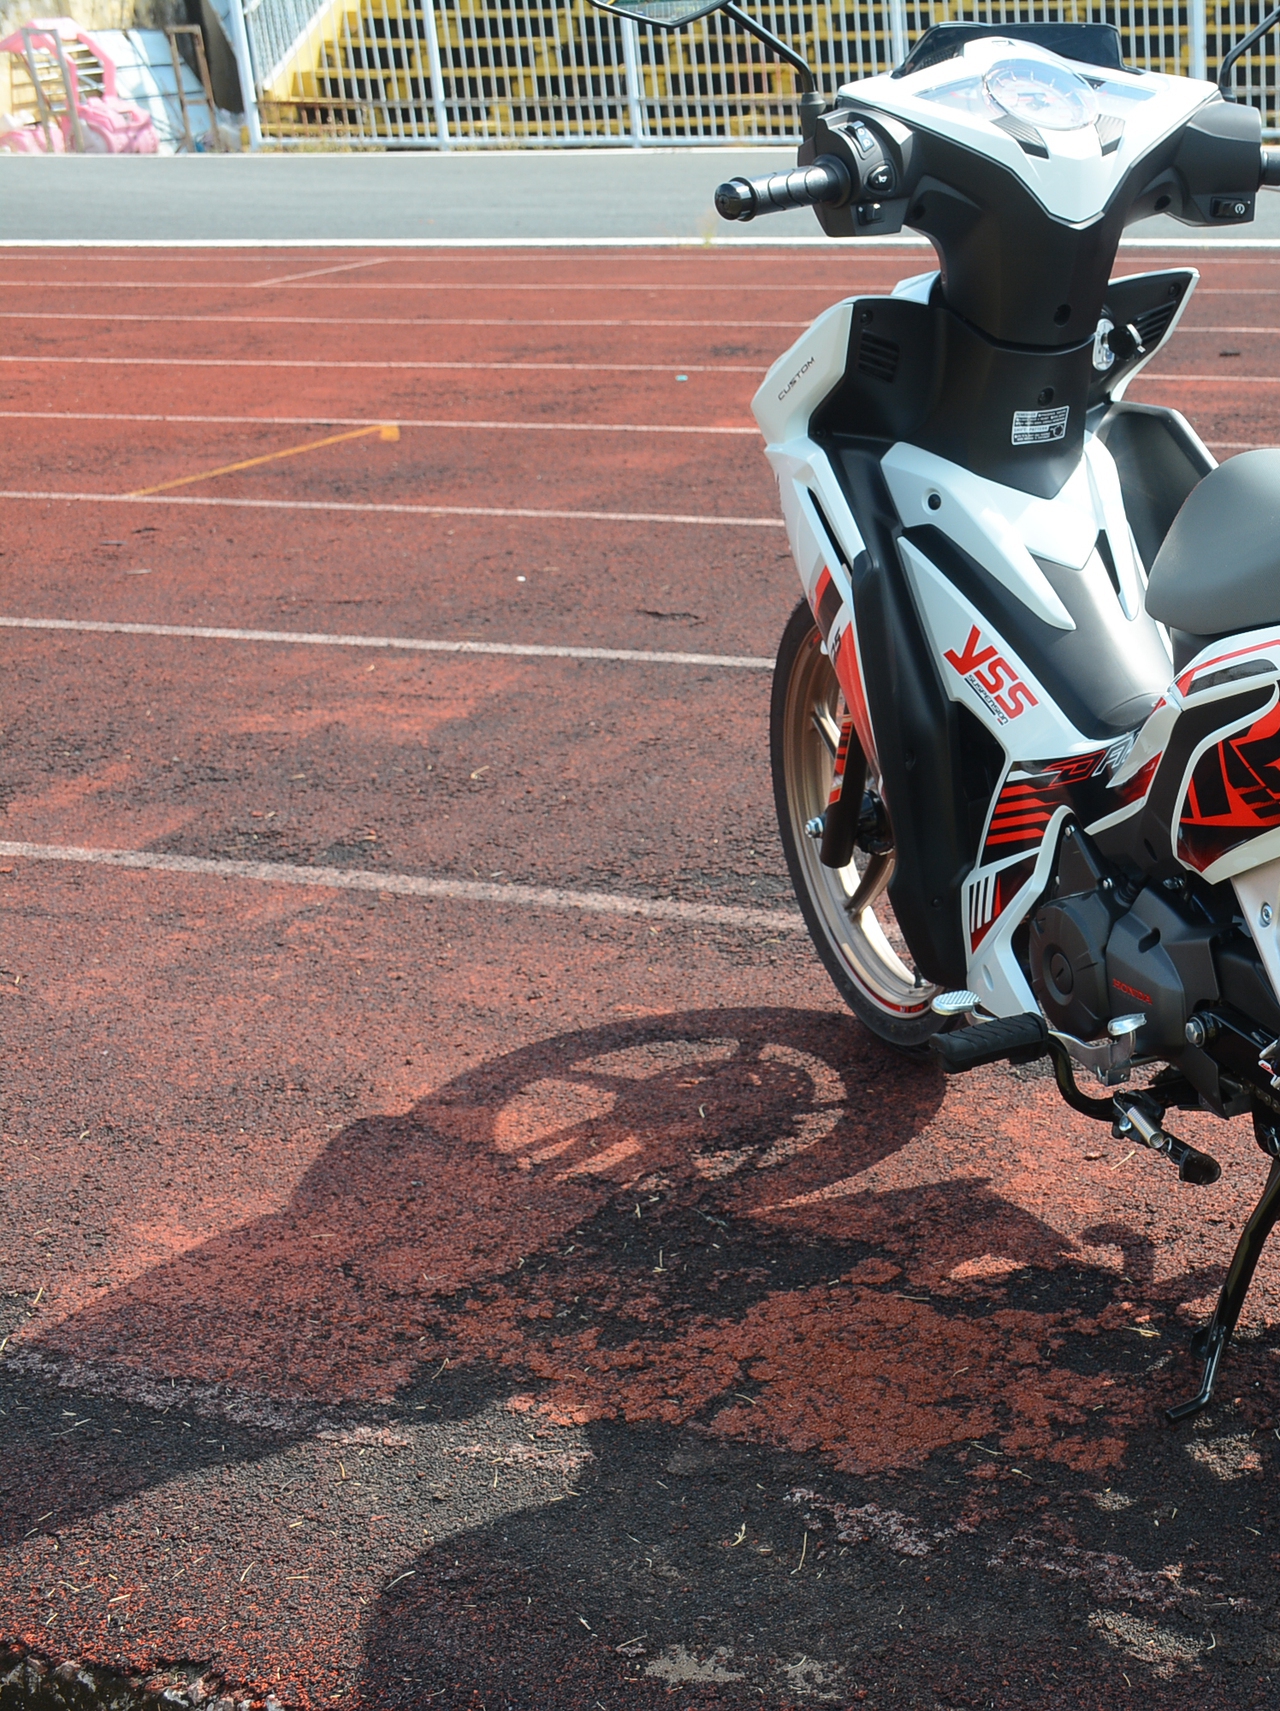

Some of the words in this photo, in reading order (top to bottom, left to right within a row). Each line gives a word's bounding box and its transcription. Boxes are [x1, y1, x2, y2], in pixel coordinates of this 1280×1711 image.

[778, 356, 815, 401] CUSTOM
[943, 624, 1039, 720] YSS
[1112, 978, 1153, 1006] HONDA
